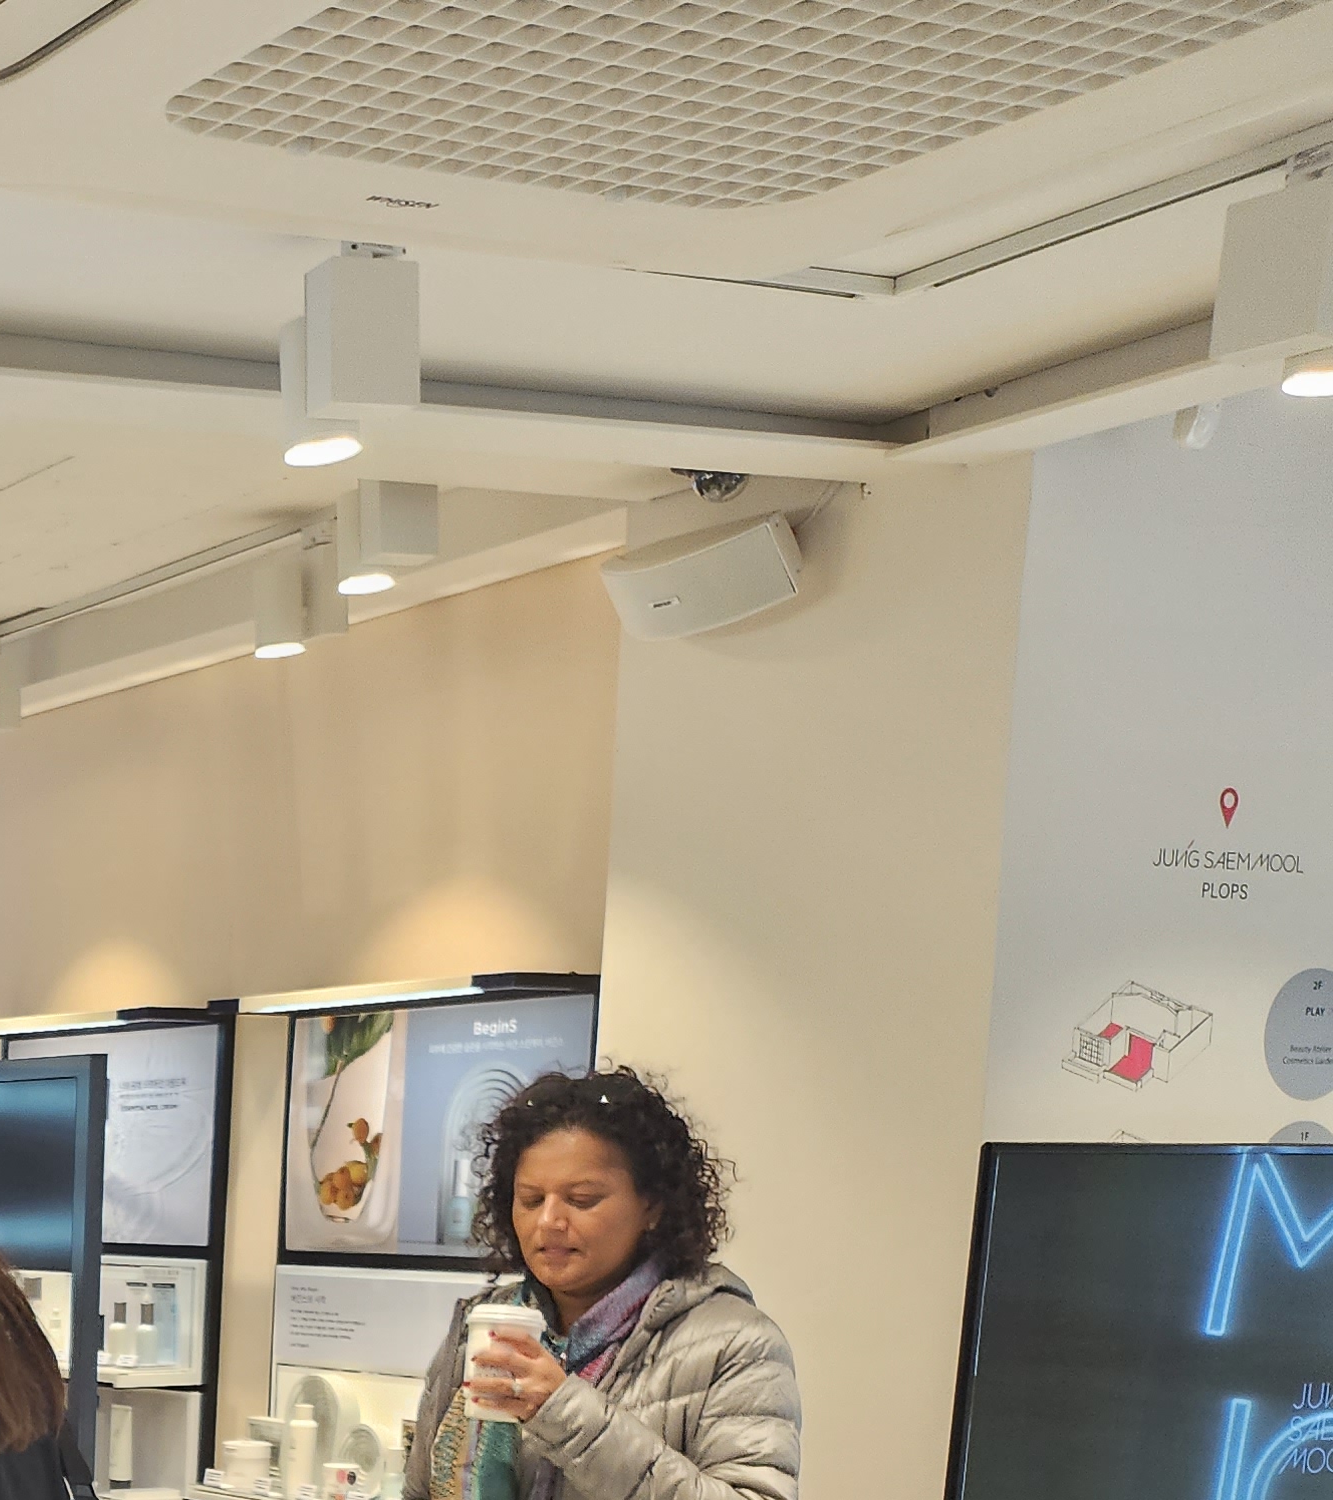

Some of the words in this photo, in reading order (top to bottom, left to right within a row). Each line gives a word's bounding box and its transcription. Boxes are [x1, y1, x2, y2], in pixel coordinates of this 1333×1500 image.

[1202, 882, 1248, 900] PLOPS
[1313, 980, 1323, 990] 2F
[1305, 1007, 1325, 1017] PLAY
